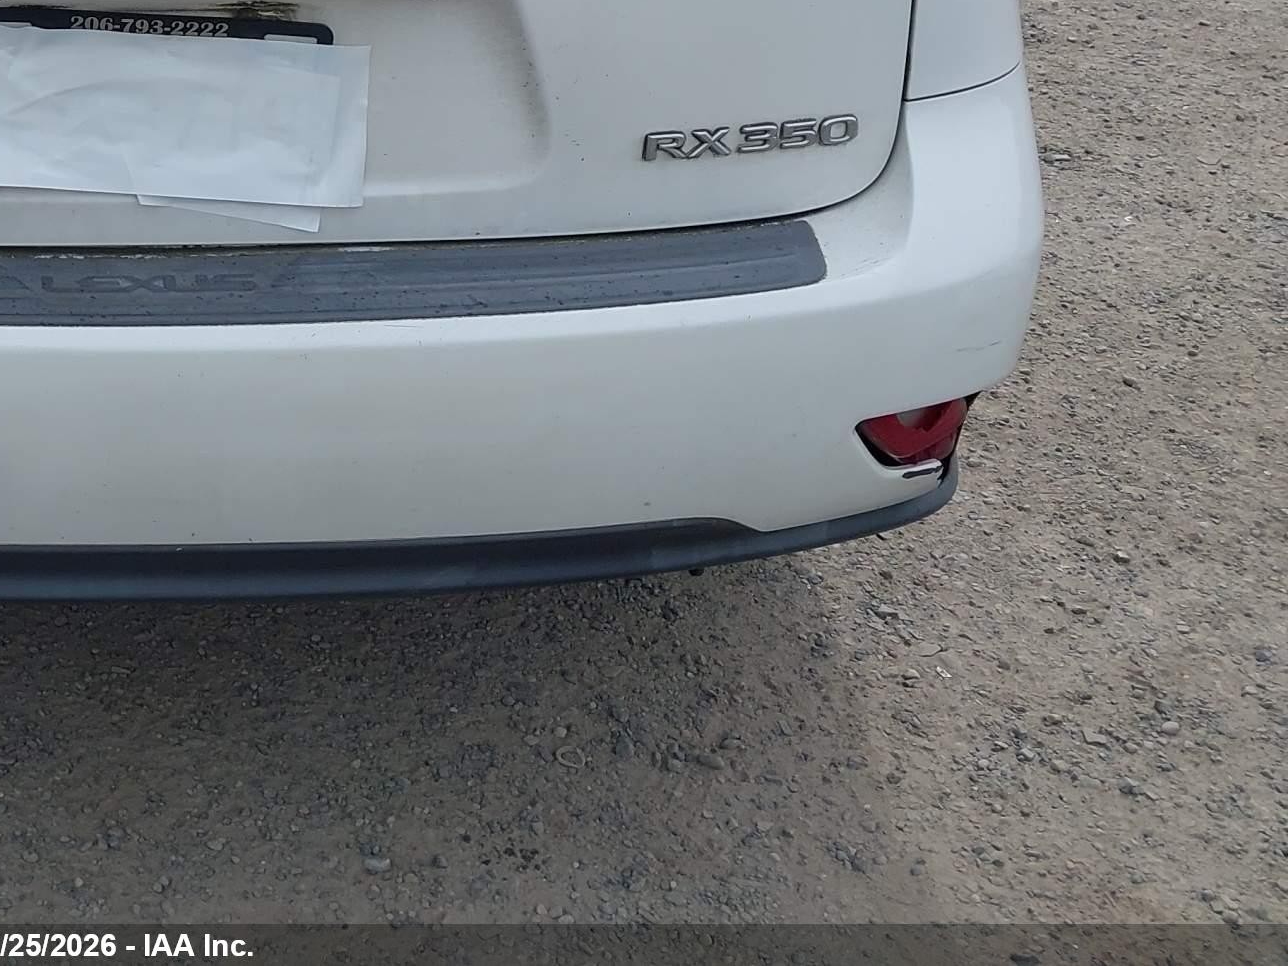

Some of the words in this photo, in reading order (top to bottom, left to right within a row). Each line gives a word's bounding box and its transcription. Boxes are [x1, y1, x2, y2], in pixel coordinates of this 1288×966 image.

[70, 15, 229, 37] 206-793-2222
[642, 126, 731, 161] RX
[736, 113, 859, 154] 350
[40, 273, 257, 294] LEXUS
